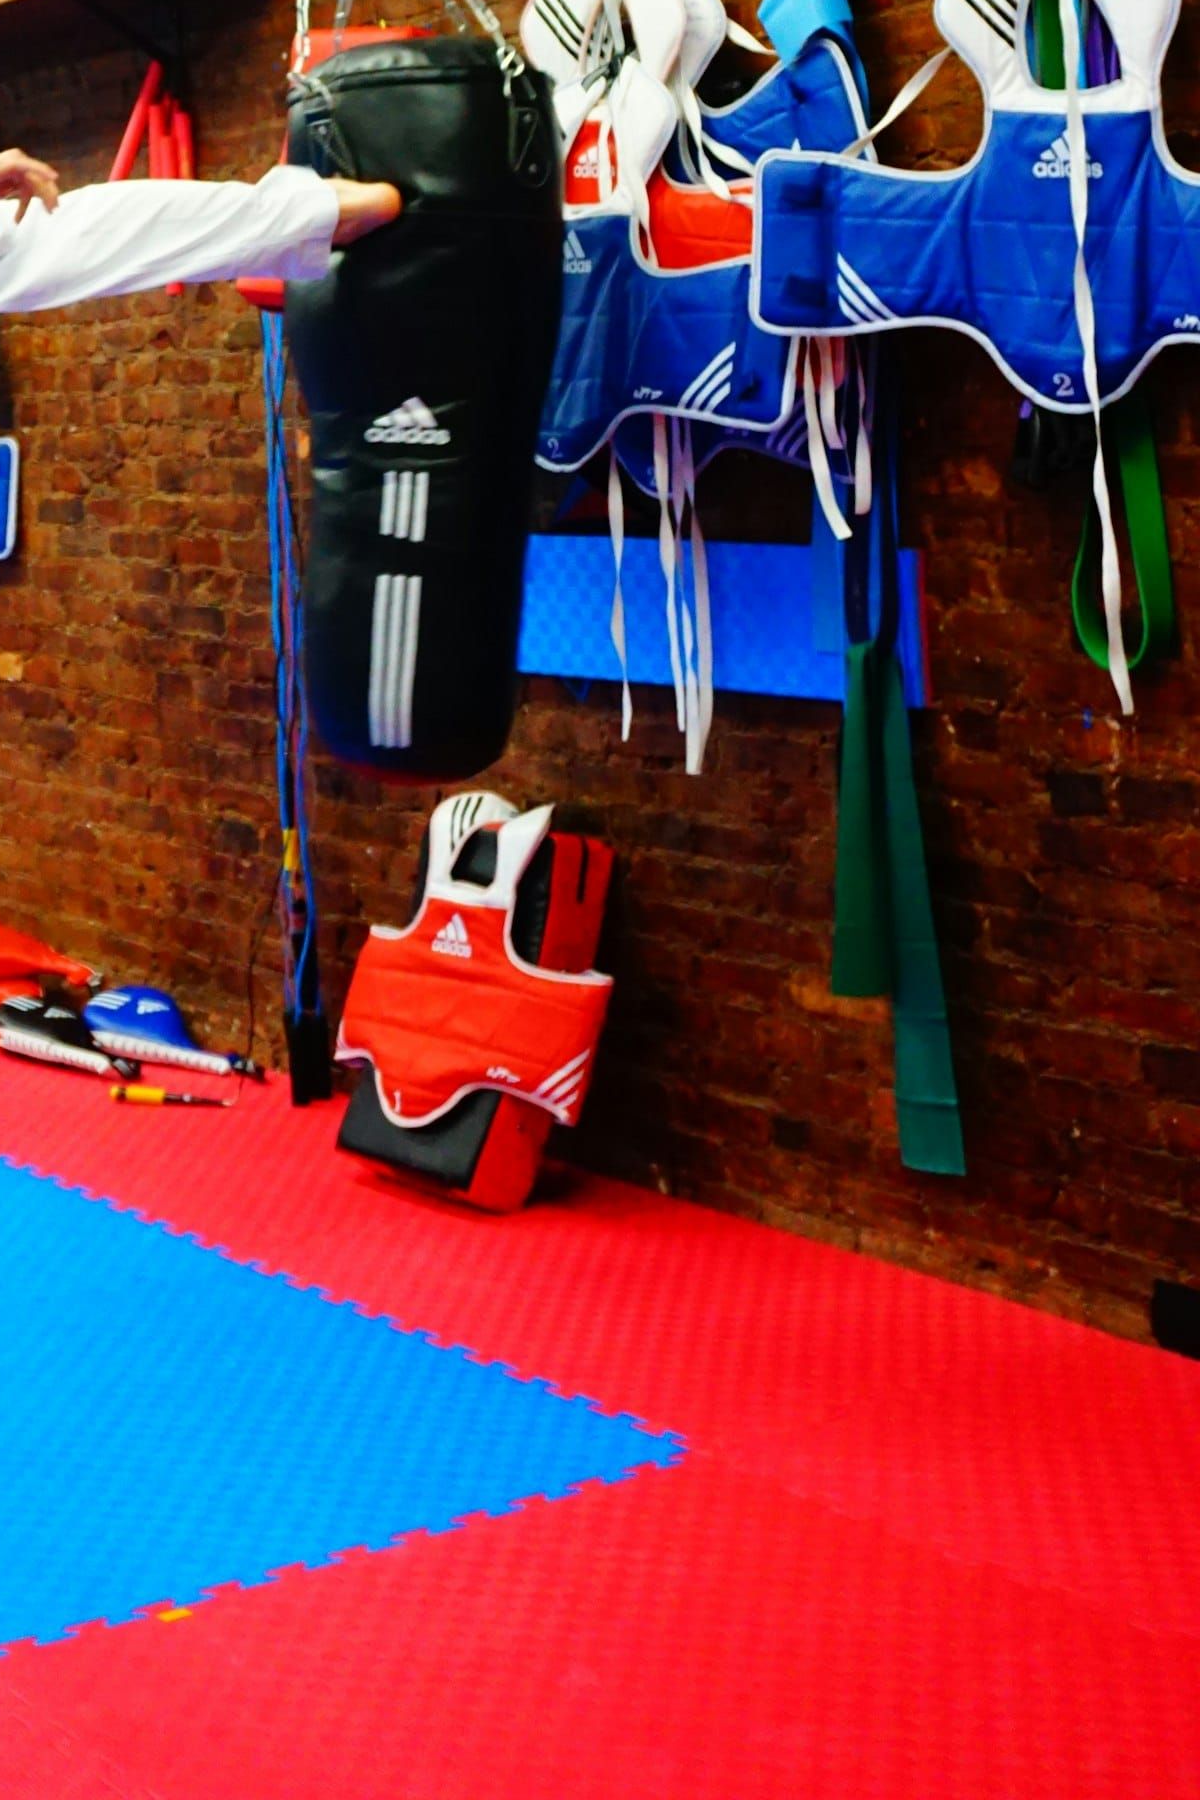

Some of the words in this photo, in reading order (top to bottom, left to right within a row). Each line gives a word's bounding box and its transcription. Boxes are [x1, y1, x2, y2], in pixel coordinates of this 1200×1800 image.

[1052, 372, 1075, 398] 2
[363, 426, 451, 446] adidas
[547, 437, 563, 459] 2
